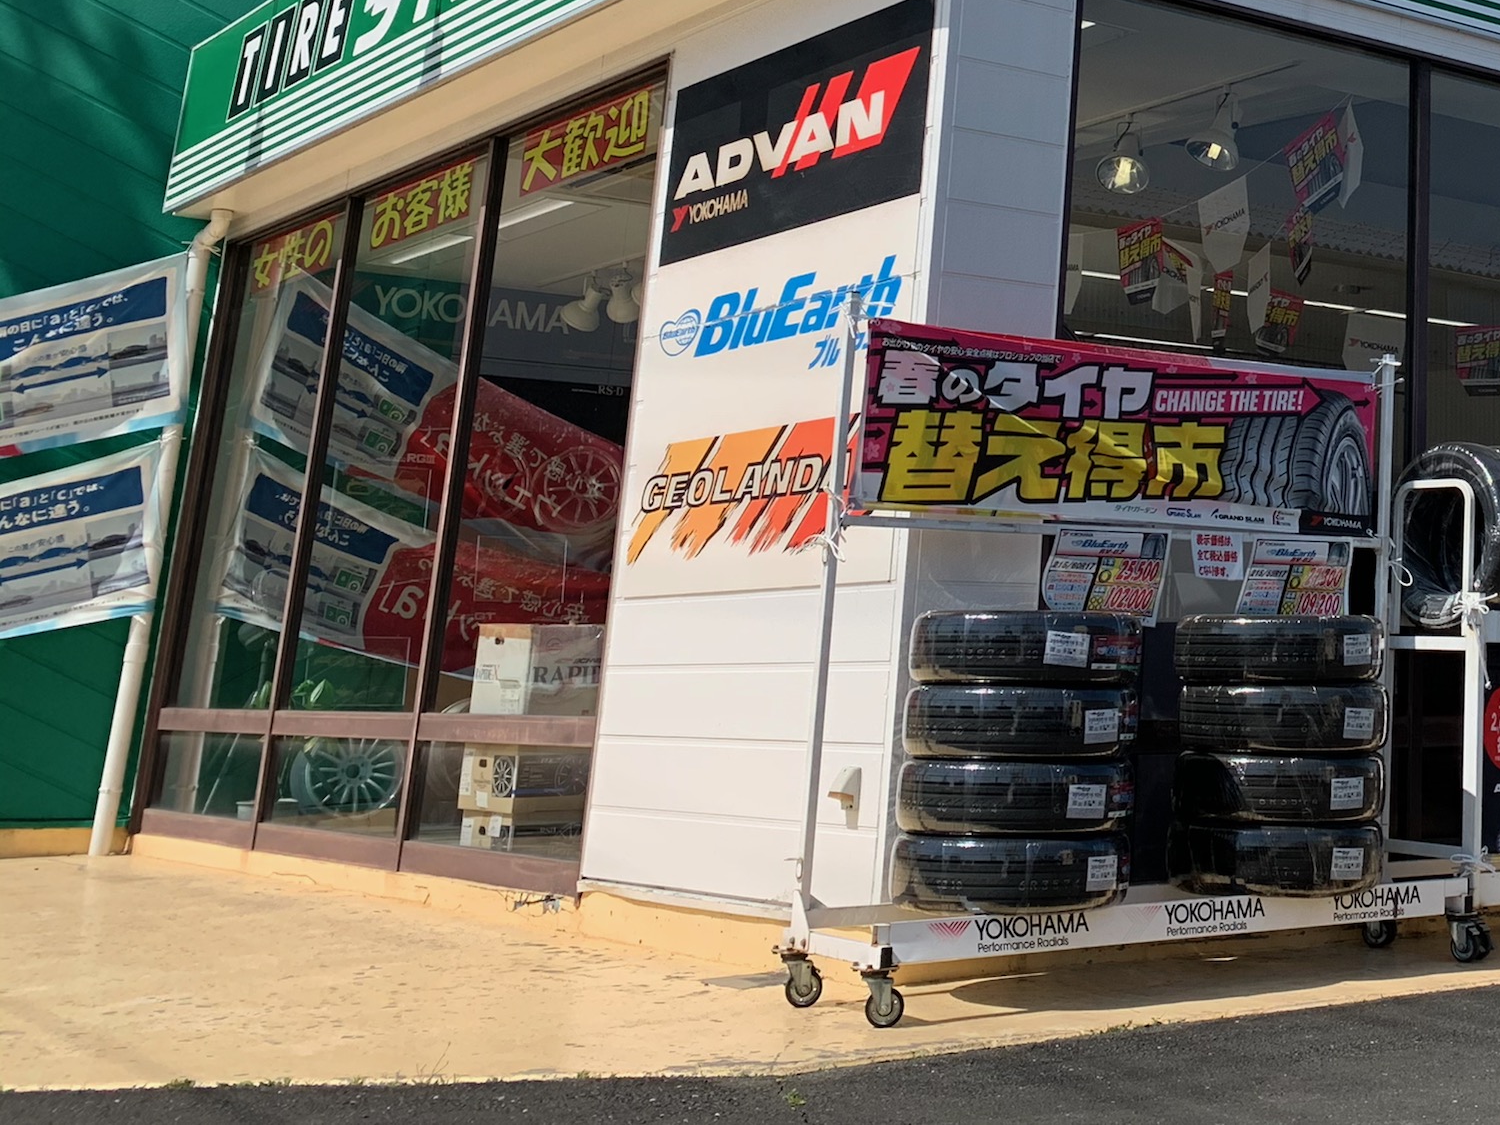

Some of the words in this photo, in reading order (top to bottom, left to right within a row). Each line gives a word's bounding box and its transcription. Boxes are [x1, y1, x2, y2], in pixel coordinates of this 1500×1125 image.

[673, 91, 885, 201] ADVAN
[253, 220, 333, 289] 女性の
[370, 162, 475, 250] お客様
[522, 87, 650, 192] 大歓迎
[687, 189, 749, 225] YOKOHAMA
[375, 284, 571, 336] YOKOAMA
[694, 255, 901, 357] BluEarth
[877, 350, 1154, 420] 春のタイヤ
[1155, 389, 1226, 413] CHANGE
[1229, 389, 1267, 413] THE
[1269, 389, 1304, 412] TIRE!
[881, 409, 1227, 502] 替え得市
[641, 450, 852, 512] GEOLAND
[1081, 539, 1129, 550] BluEarth
[1164, 897, 1265, 925] YOKOHAMA
[1333, 885, 1421, 911] YOKOHAMA
[975, 911, 1090, 940] YOKOHAMA
[1167, 923, 1218, 937] Performance
[1219, 921, 1248, 932] Radials
[978, 939, 1036, 954] Performance
[1037, 936, 1070, 950] Radials
